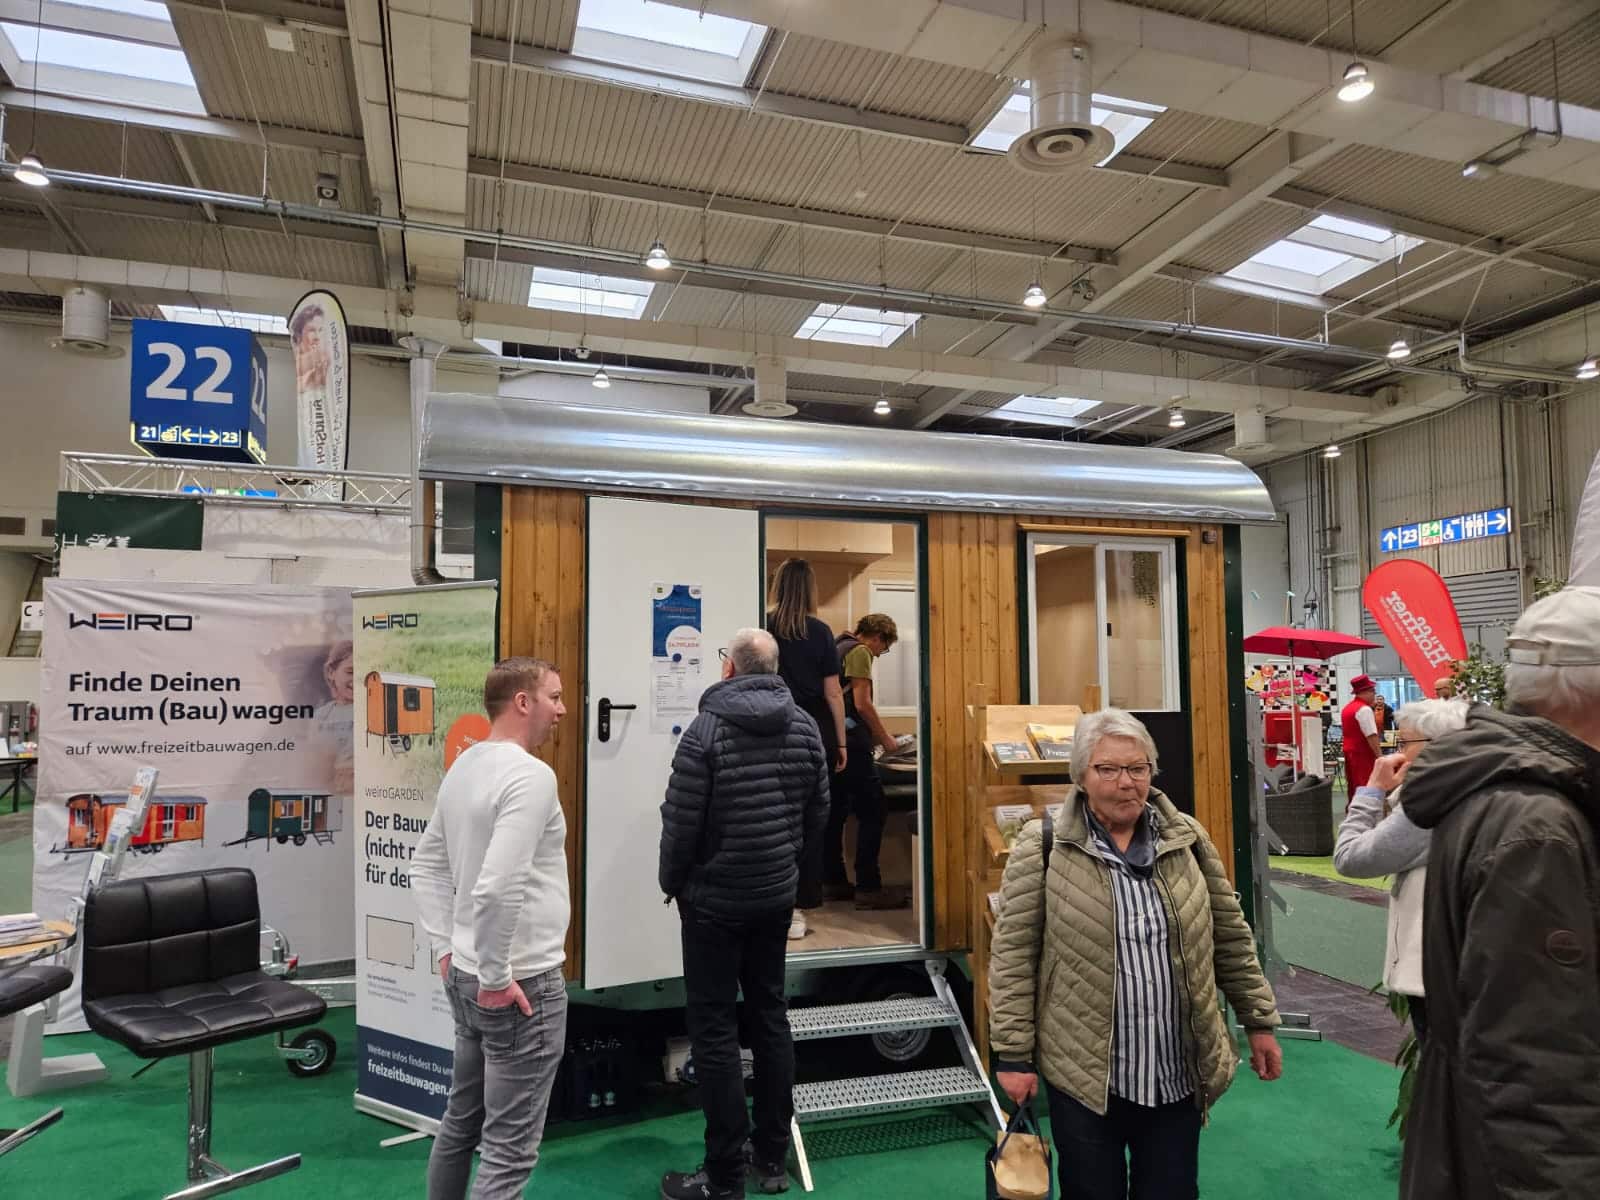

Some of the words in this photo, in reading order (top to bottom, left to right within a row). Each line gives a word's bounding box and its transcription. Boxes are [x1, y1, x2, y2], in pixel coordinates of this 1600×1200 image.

[146, 342, 233, 404] 22
[141, 426, 157, 438] 21
[222, 432, 238, 443] 23
[1402, 529, 1418, 544] 23
[69, 612, 193, 631] WEIRO
[363, 613, 418, 629] WEIRO
[69, 671, 142, 692] Finde
[151, 672, 241, 692] Deinen
[68, 703, 153, 721] Traum
[65, 742, 92, 755] auf
[97, 739, 296, 755] www.freizeitbauwagen.de
[366, 810, 389, 830] Der
[393, 813, 430, 834] Bauw
[366, 833, 405, 860] (nicht
[366, 862, 386, 885] für
[368, 1058, 456, 1096] freizeitbauwagen.
[432, 1062, 441, 1074] Du
